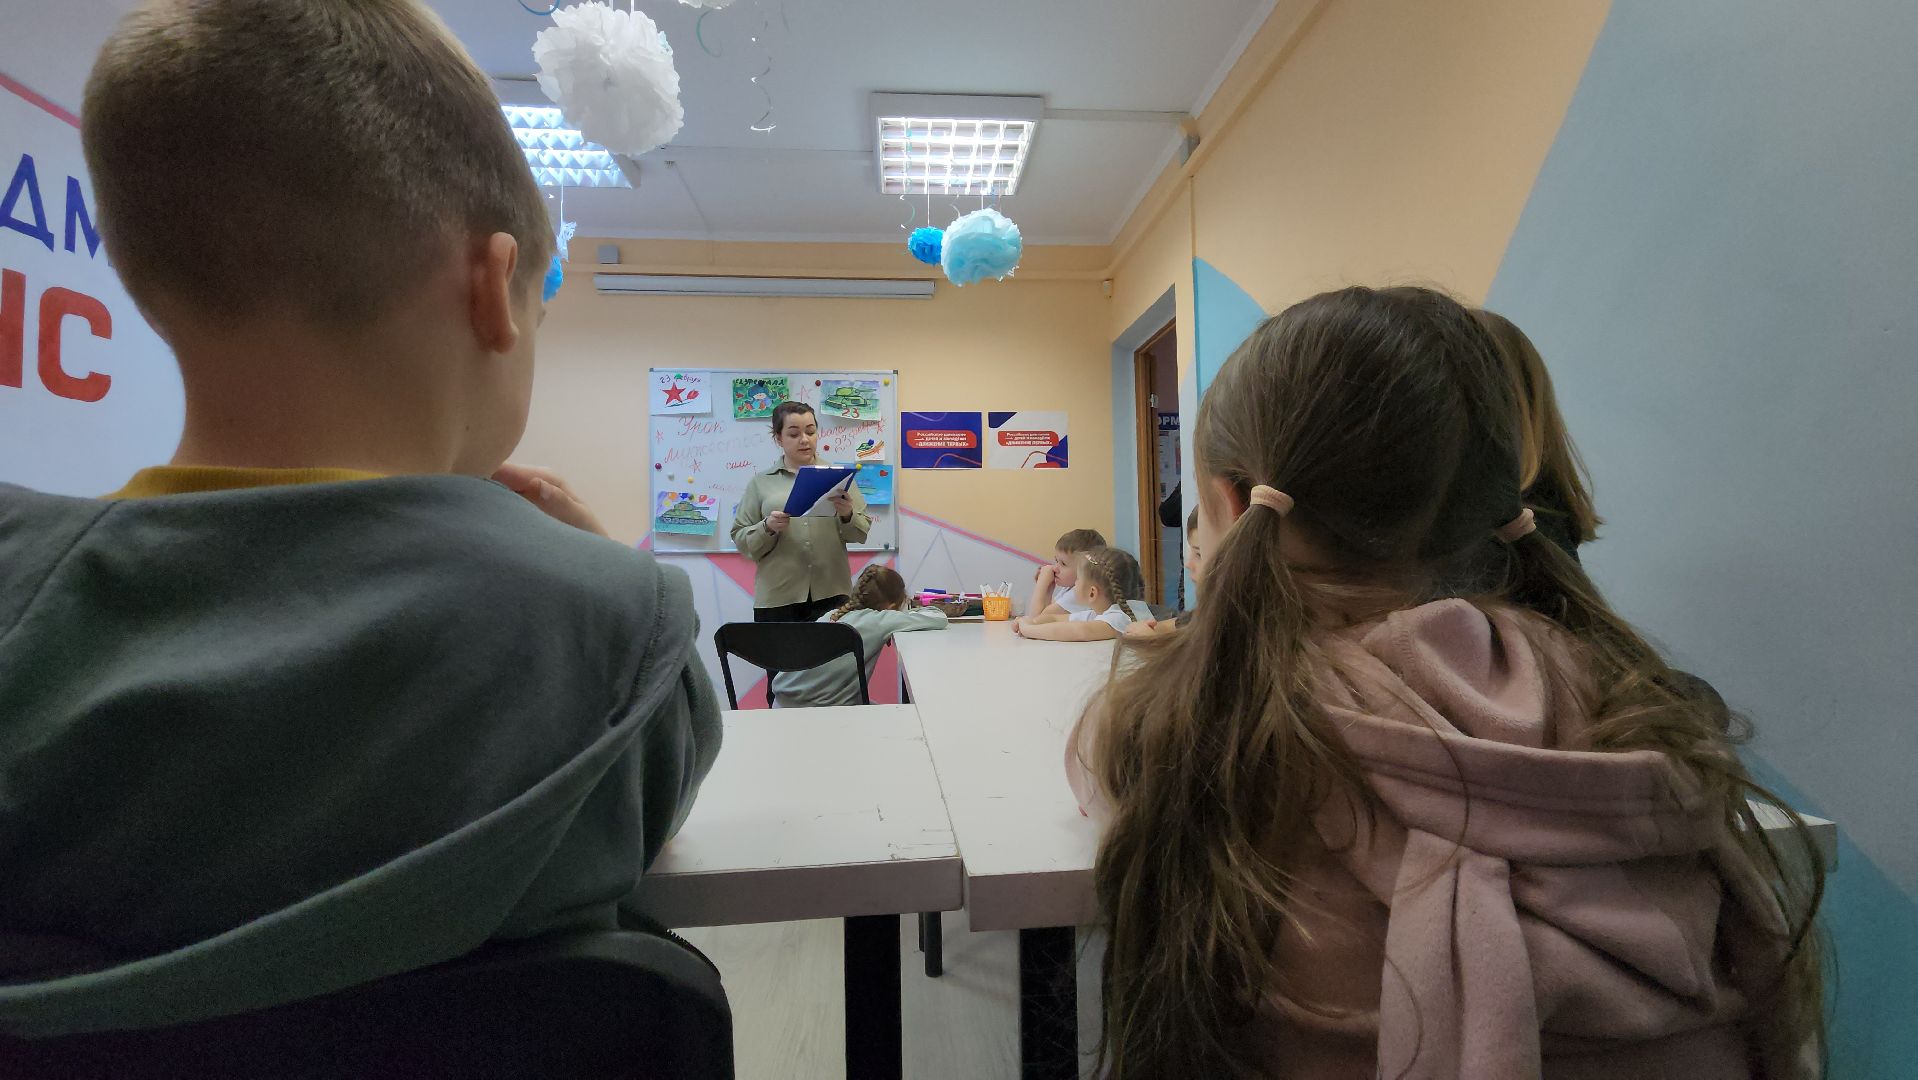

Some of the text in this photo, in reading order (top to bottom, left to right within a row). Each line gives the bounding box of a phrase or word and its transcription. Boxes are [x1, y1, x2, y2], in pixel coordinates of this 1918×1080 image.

[660, 374, 671, 384] 23
[841, 407, 860, 419] 23
[1158, 415, 1180, 426] РМ
